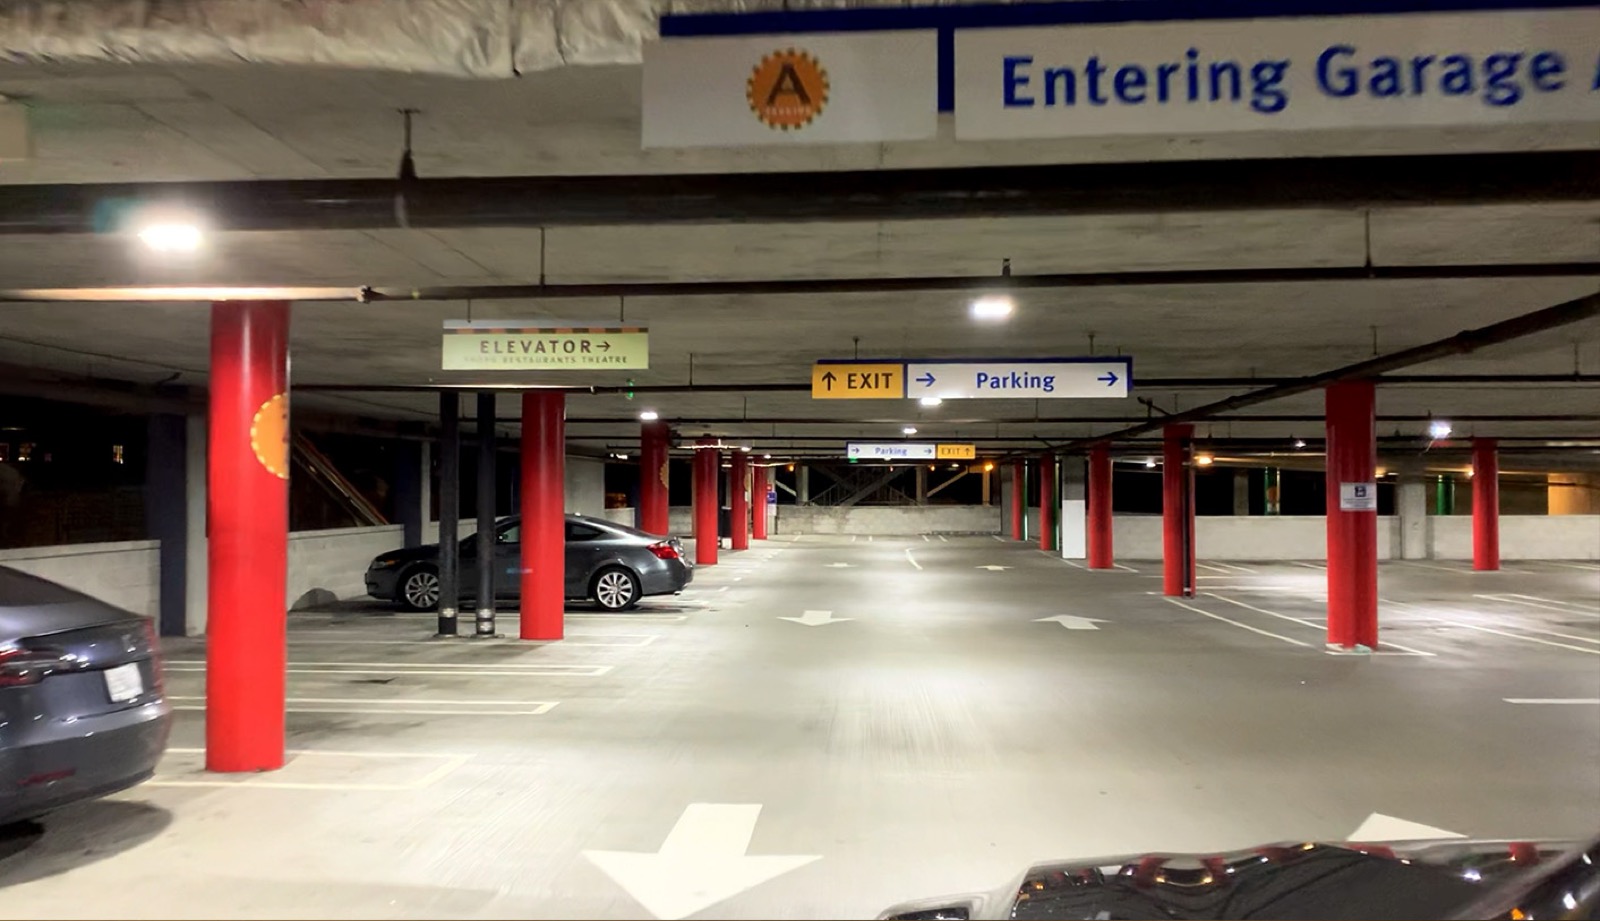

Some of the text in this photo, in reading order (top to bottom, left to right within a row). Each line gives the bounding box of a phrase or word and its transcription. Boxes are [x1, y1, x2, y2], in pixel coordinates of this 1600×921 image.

[765, 62, 812, 106] A
[1003, 47, 1291, 114] Entering
[1315, 43, 1568, 107] Garage
[479, 340, 592, 354] ELEVATOR
[502, 356, 576, 364] RESTAURANTS
[581, 356, 627, 364] THEATRE
[847, 373, 894, 389] EXIT
[976, 372, 1056, 392] Parking
[874, 446, 908, 457] Parking
[941, 447, 961, 456] EXIT
